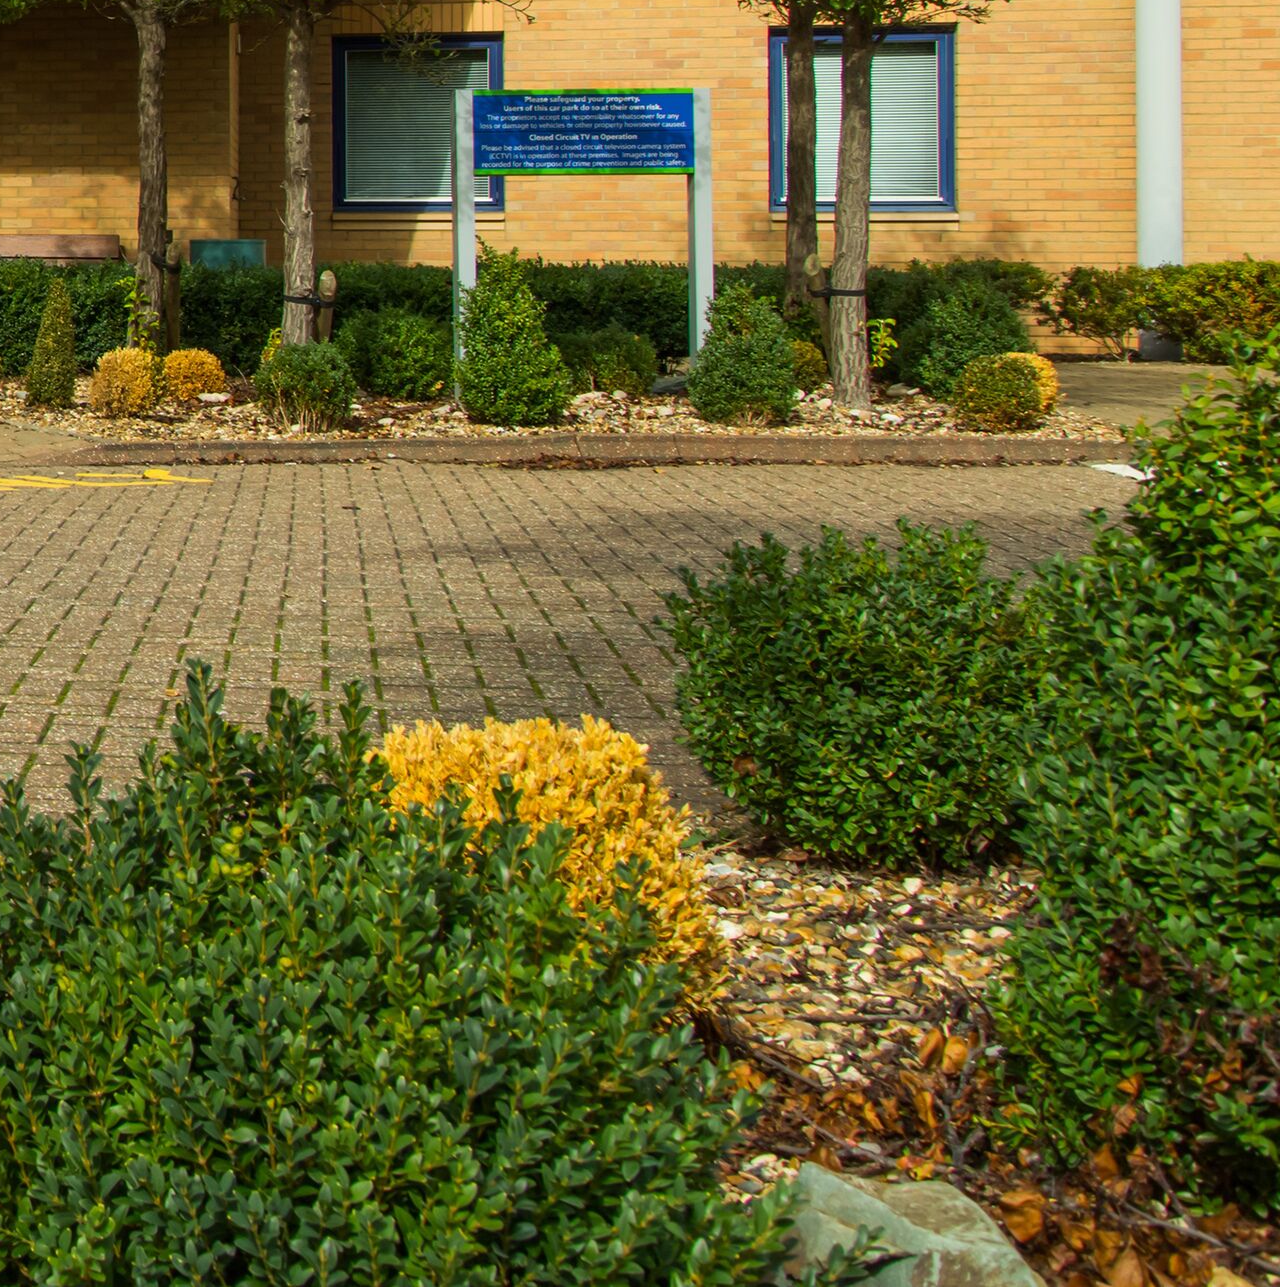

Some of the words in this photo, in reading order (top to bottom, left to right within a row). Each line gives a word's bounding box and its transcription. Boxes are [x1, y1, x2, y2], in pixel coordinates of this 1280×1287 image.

[606, 95, 640, 104] property.
[572, 113, 616, 121] responsibility
[600, 133, 638, 141] Operation
[592, 159, 628, 167] prevention
[643, 159, 664, 167] public
[666, 159, 686, 167] safety.
